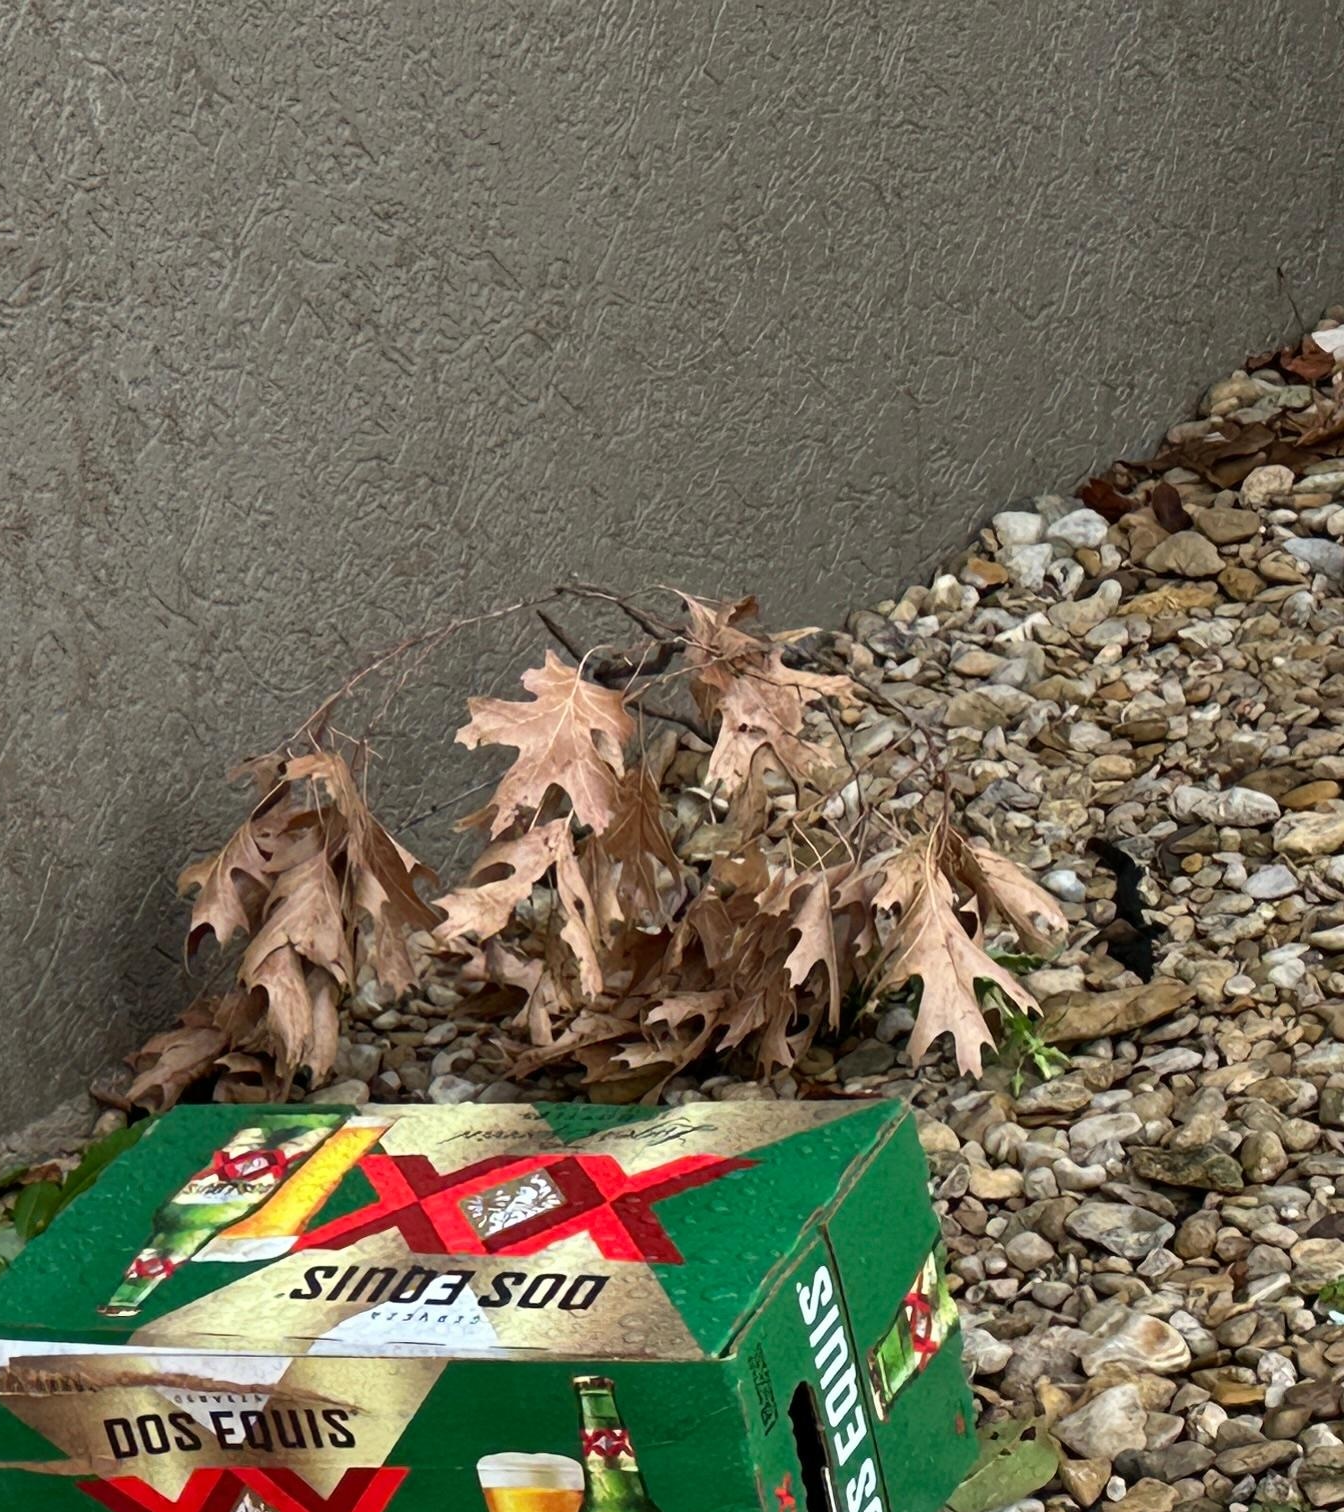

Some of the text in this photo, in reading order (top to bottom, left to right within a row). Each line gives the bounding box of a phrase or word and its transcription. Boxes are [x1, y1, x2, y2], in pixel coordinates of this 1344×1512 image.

[289, 1265, 611, 1311] DOS EQUIS
[800, 1265, 869, 1466] EQUIS
[103, 1408, 357, 1459] DOS EQUIS
